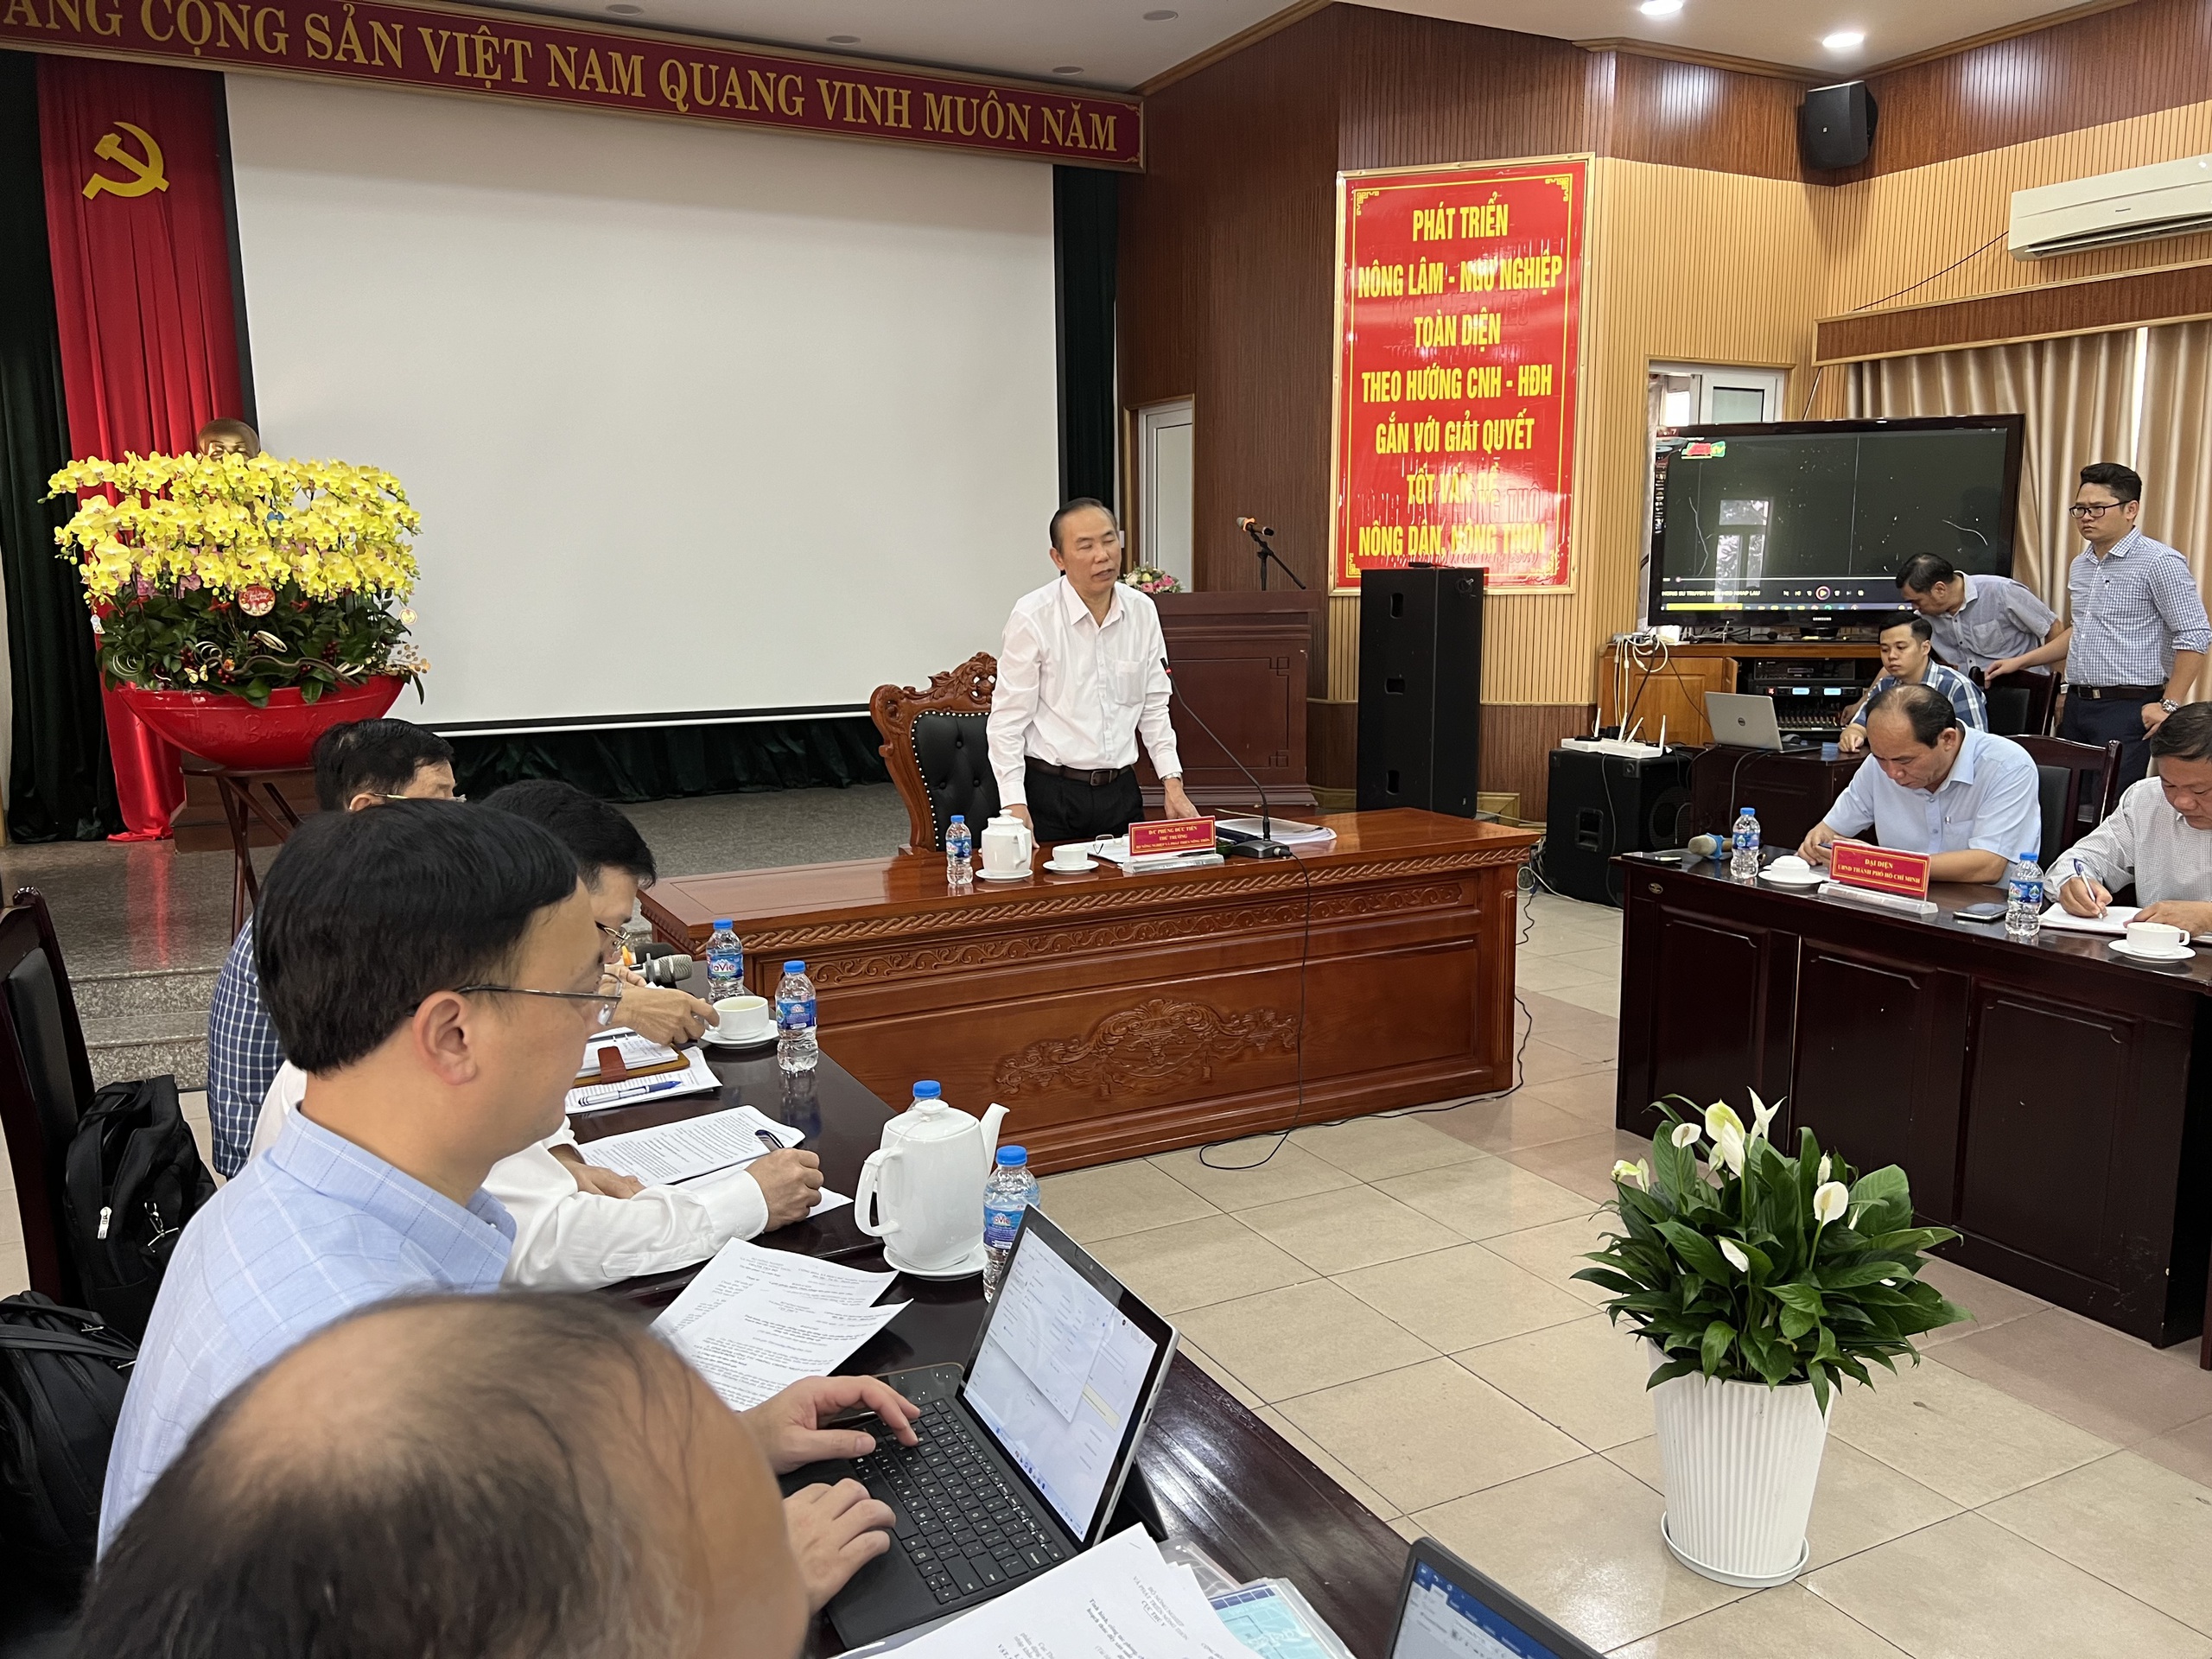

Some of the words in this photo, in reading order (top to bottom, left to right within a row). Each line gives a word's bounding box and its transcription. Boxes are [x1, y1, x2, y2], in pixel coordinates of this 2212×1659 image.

[306, 5, 404, 69] SẢN
[418, 25, 532, 89] VIỆT
[546, 43, 646, 98] NAM
[659, 59, 805, 117] QUANG
[817, 79, 912, 129] VINH
[924, 90, 1031, 143] MUÔN
[1041, 100, 1117, 151] NĂM
[1413, 201, 1455, 242] PHÁT
[1460, 191, 1509, 238] TRIỂN
[1358, 259, 1403, 298] NÔNG
[1408, 256, 1443, 296] LÂM
[1500, 249, 1563, 295] NGHIỆP
[1414, 309, 1457, 348] TOÀN
[1461, 307, 1501, 352] DIỆN
[1362, 371, 1402, 403] THEO
[1406, 362, 1462, 401] HƯỚNG
[1467, 366, 1502, 398] CNH
[1518, 364, 1553, 397] HĐH
[1376, 411, 1409, 454] GẮN
[1414, 416, 1440, 453] VỚI
[1445, 410, 1478, 452] GIẢI
[1483, 409, 1535, 454] QUYẾT
[1407, 463, 1435, 505] TỐT
[1359, 519, 1403, 556] NÔNG
[1451, 518, 1497, 555] NÔNG
